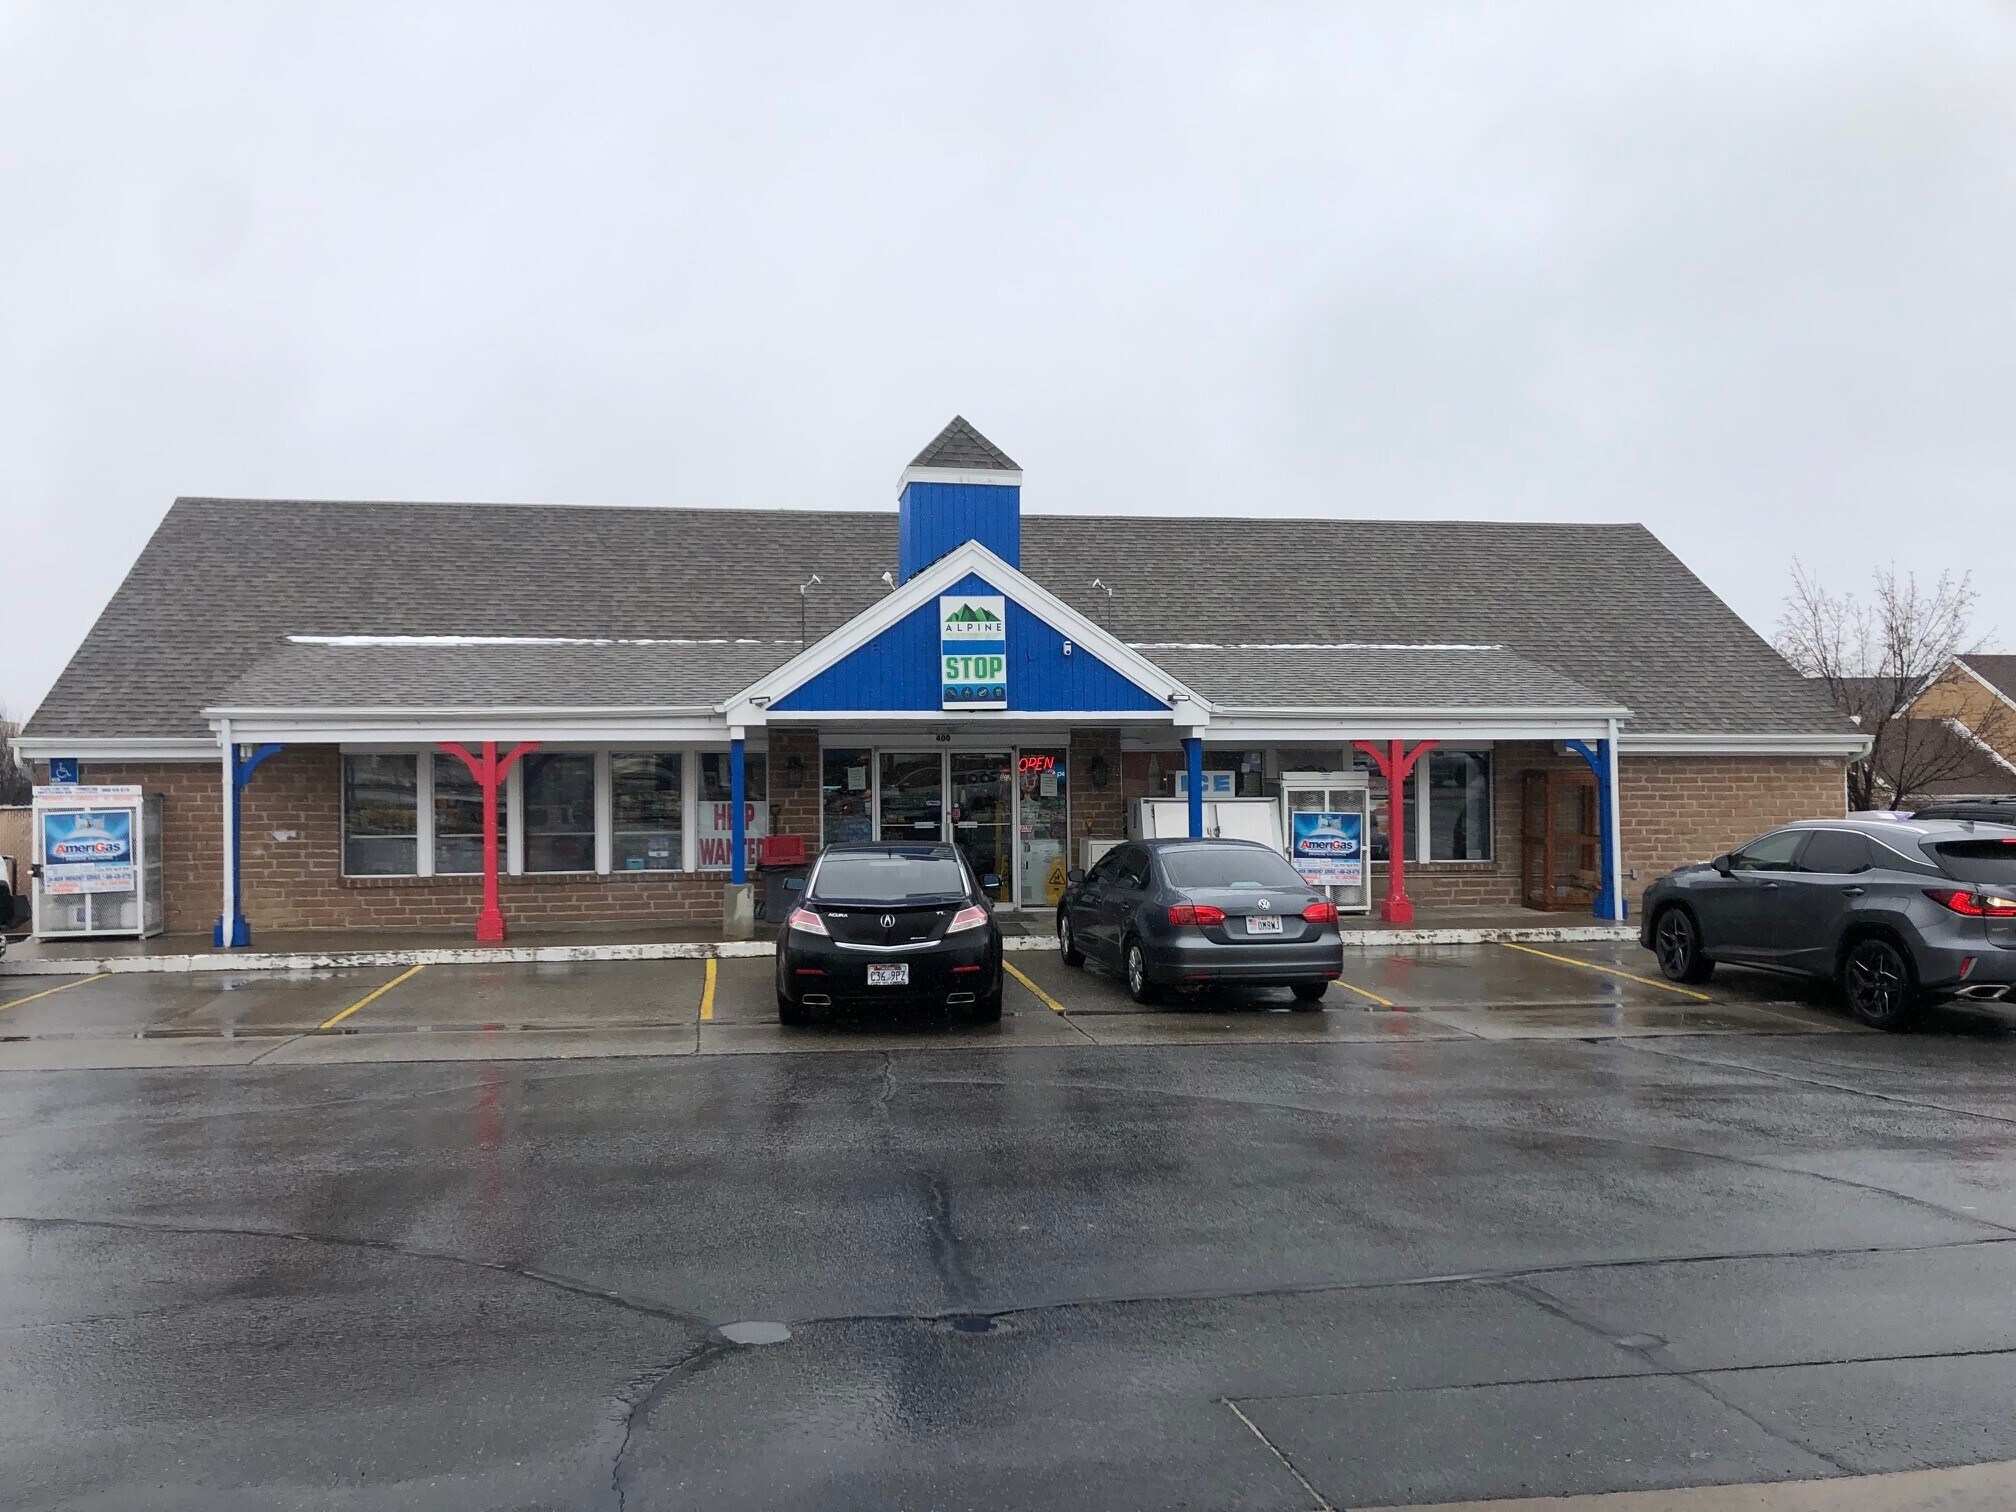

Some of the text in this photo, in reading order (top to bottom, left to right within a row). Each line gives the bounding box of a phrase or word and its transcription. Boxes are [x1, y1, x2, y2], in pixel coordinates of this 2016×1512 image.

[945, 623, 1002, 632] ALPINE
[946, 656, 1003, 679] STOP
[1018, 756, 1055, 772] OPEN
[713, 803, 755, 831] HEP
[55, 842, 121, 854] AmeriGas
[1300, 840, 1354, 851] AmeriGas
